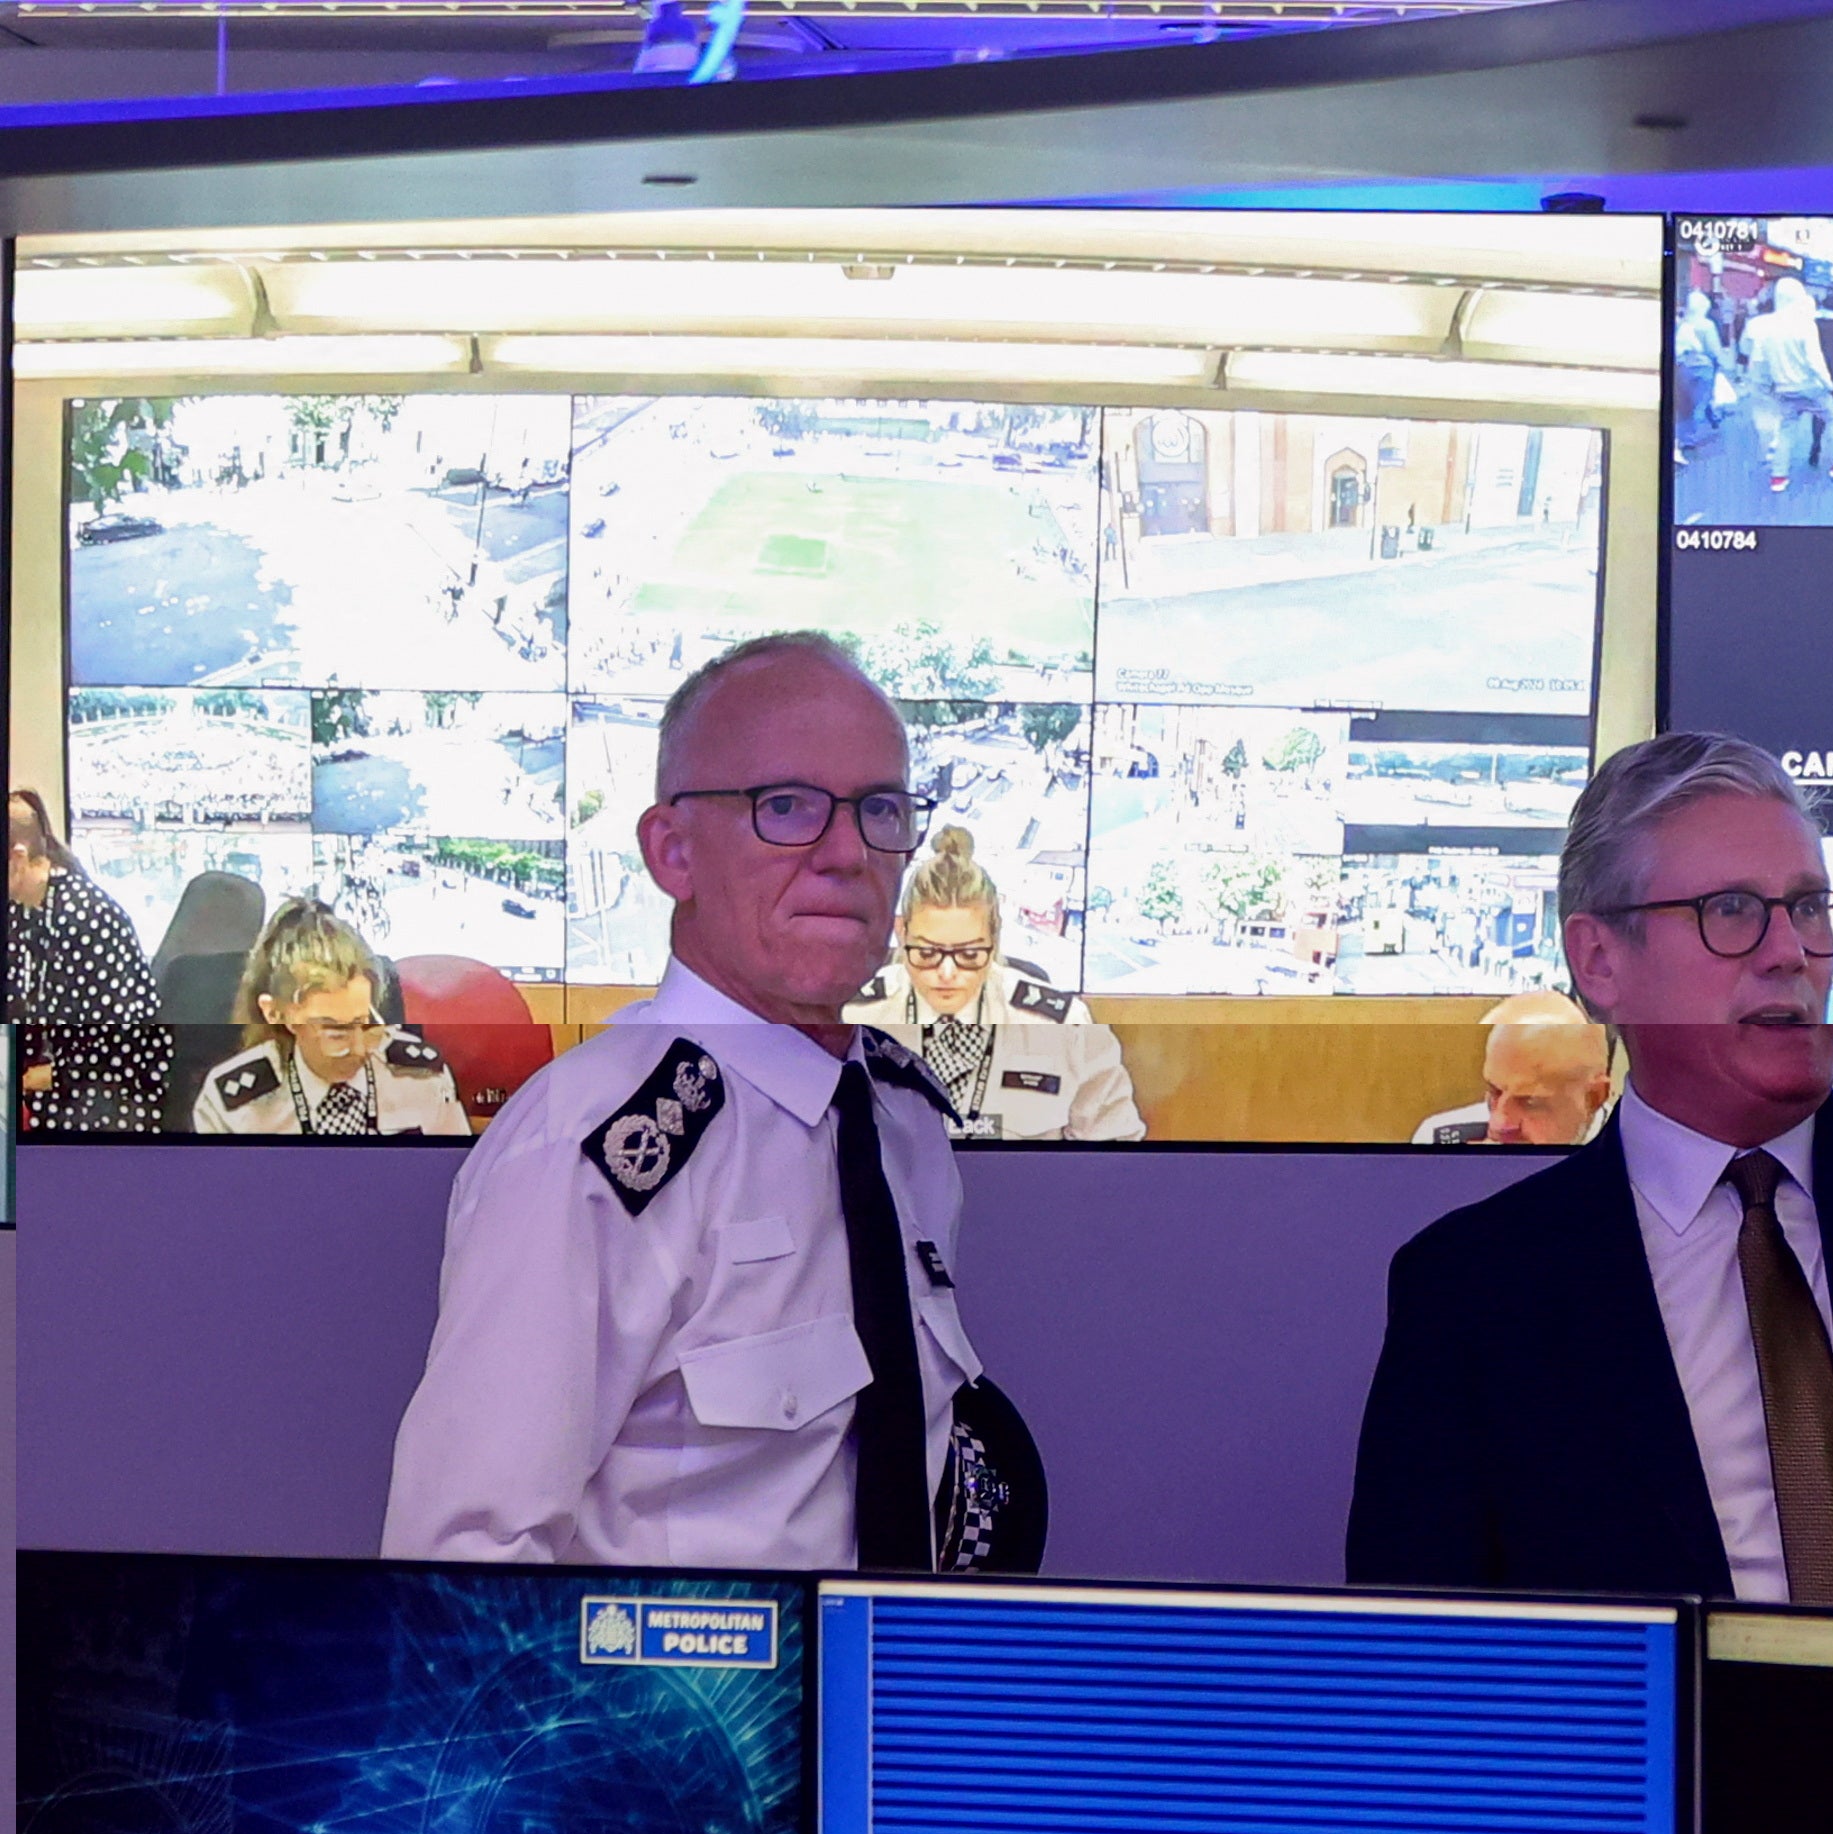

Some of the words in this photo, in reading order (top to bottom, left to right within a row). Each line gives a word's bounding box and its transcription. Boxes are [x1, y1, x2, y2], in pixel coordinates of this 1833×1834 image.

[1681, 220, 1758, 241] 0410781
[1676, 530, 1757, 550] 0410784
[648, 1610, 764, 1631] METROPOLITAN
[663, 1633, 748, 1655] POLICE
